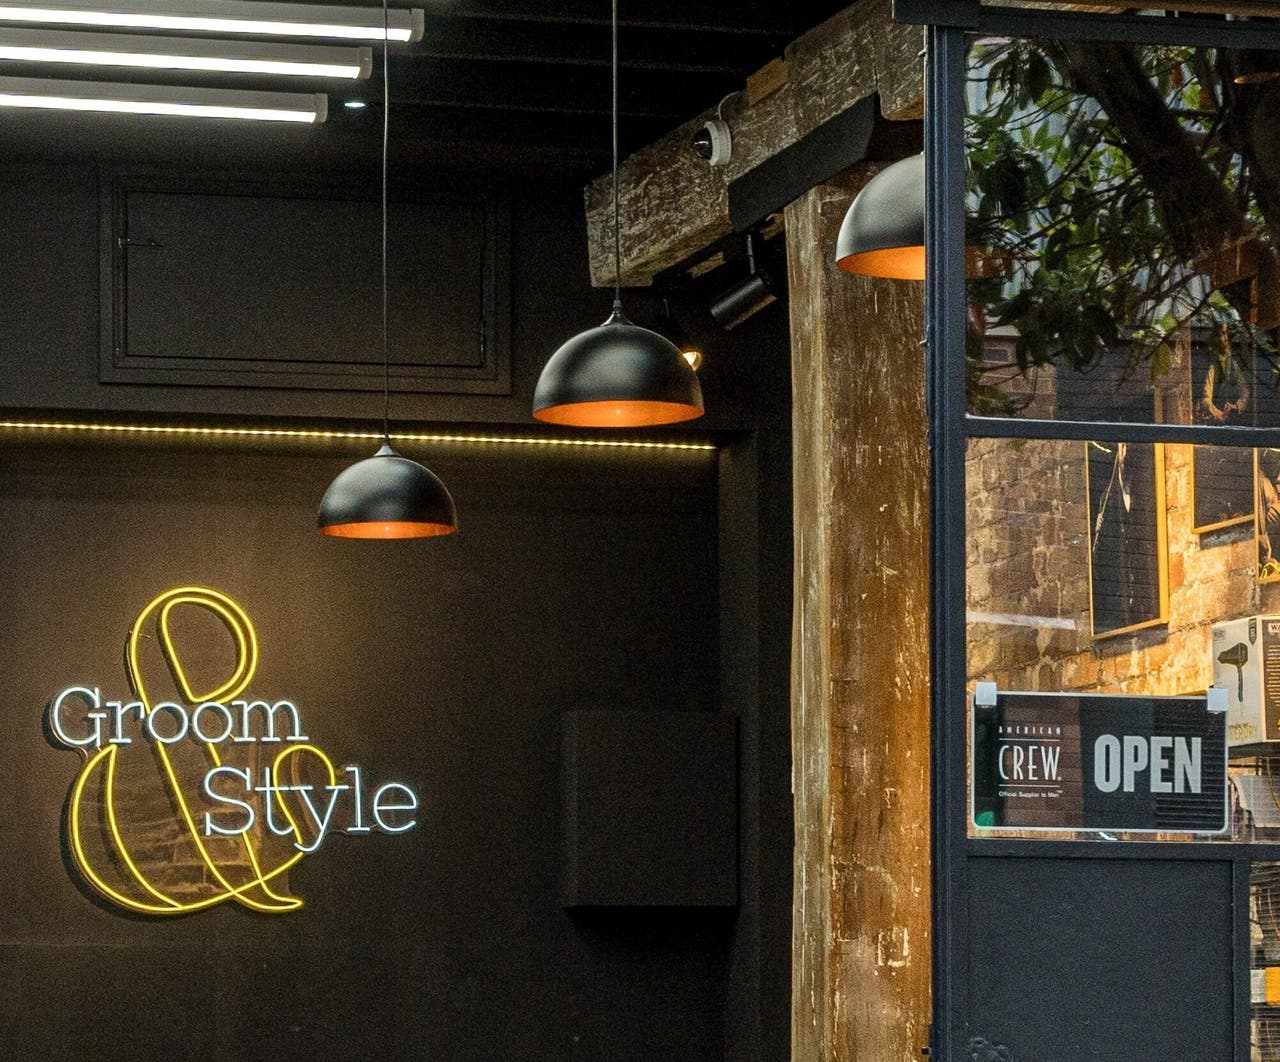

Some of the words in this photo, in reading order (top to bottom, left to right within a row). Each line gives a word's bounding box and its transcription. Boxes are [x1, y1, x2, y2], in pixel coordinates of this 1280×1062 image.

[51, 686, 310, 748] Groom
[998, 726, 1061, 736] AMERICAN
[1094, 734, 1202, 794] OPEN
[204, 765, 418, 852] Style
